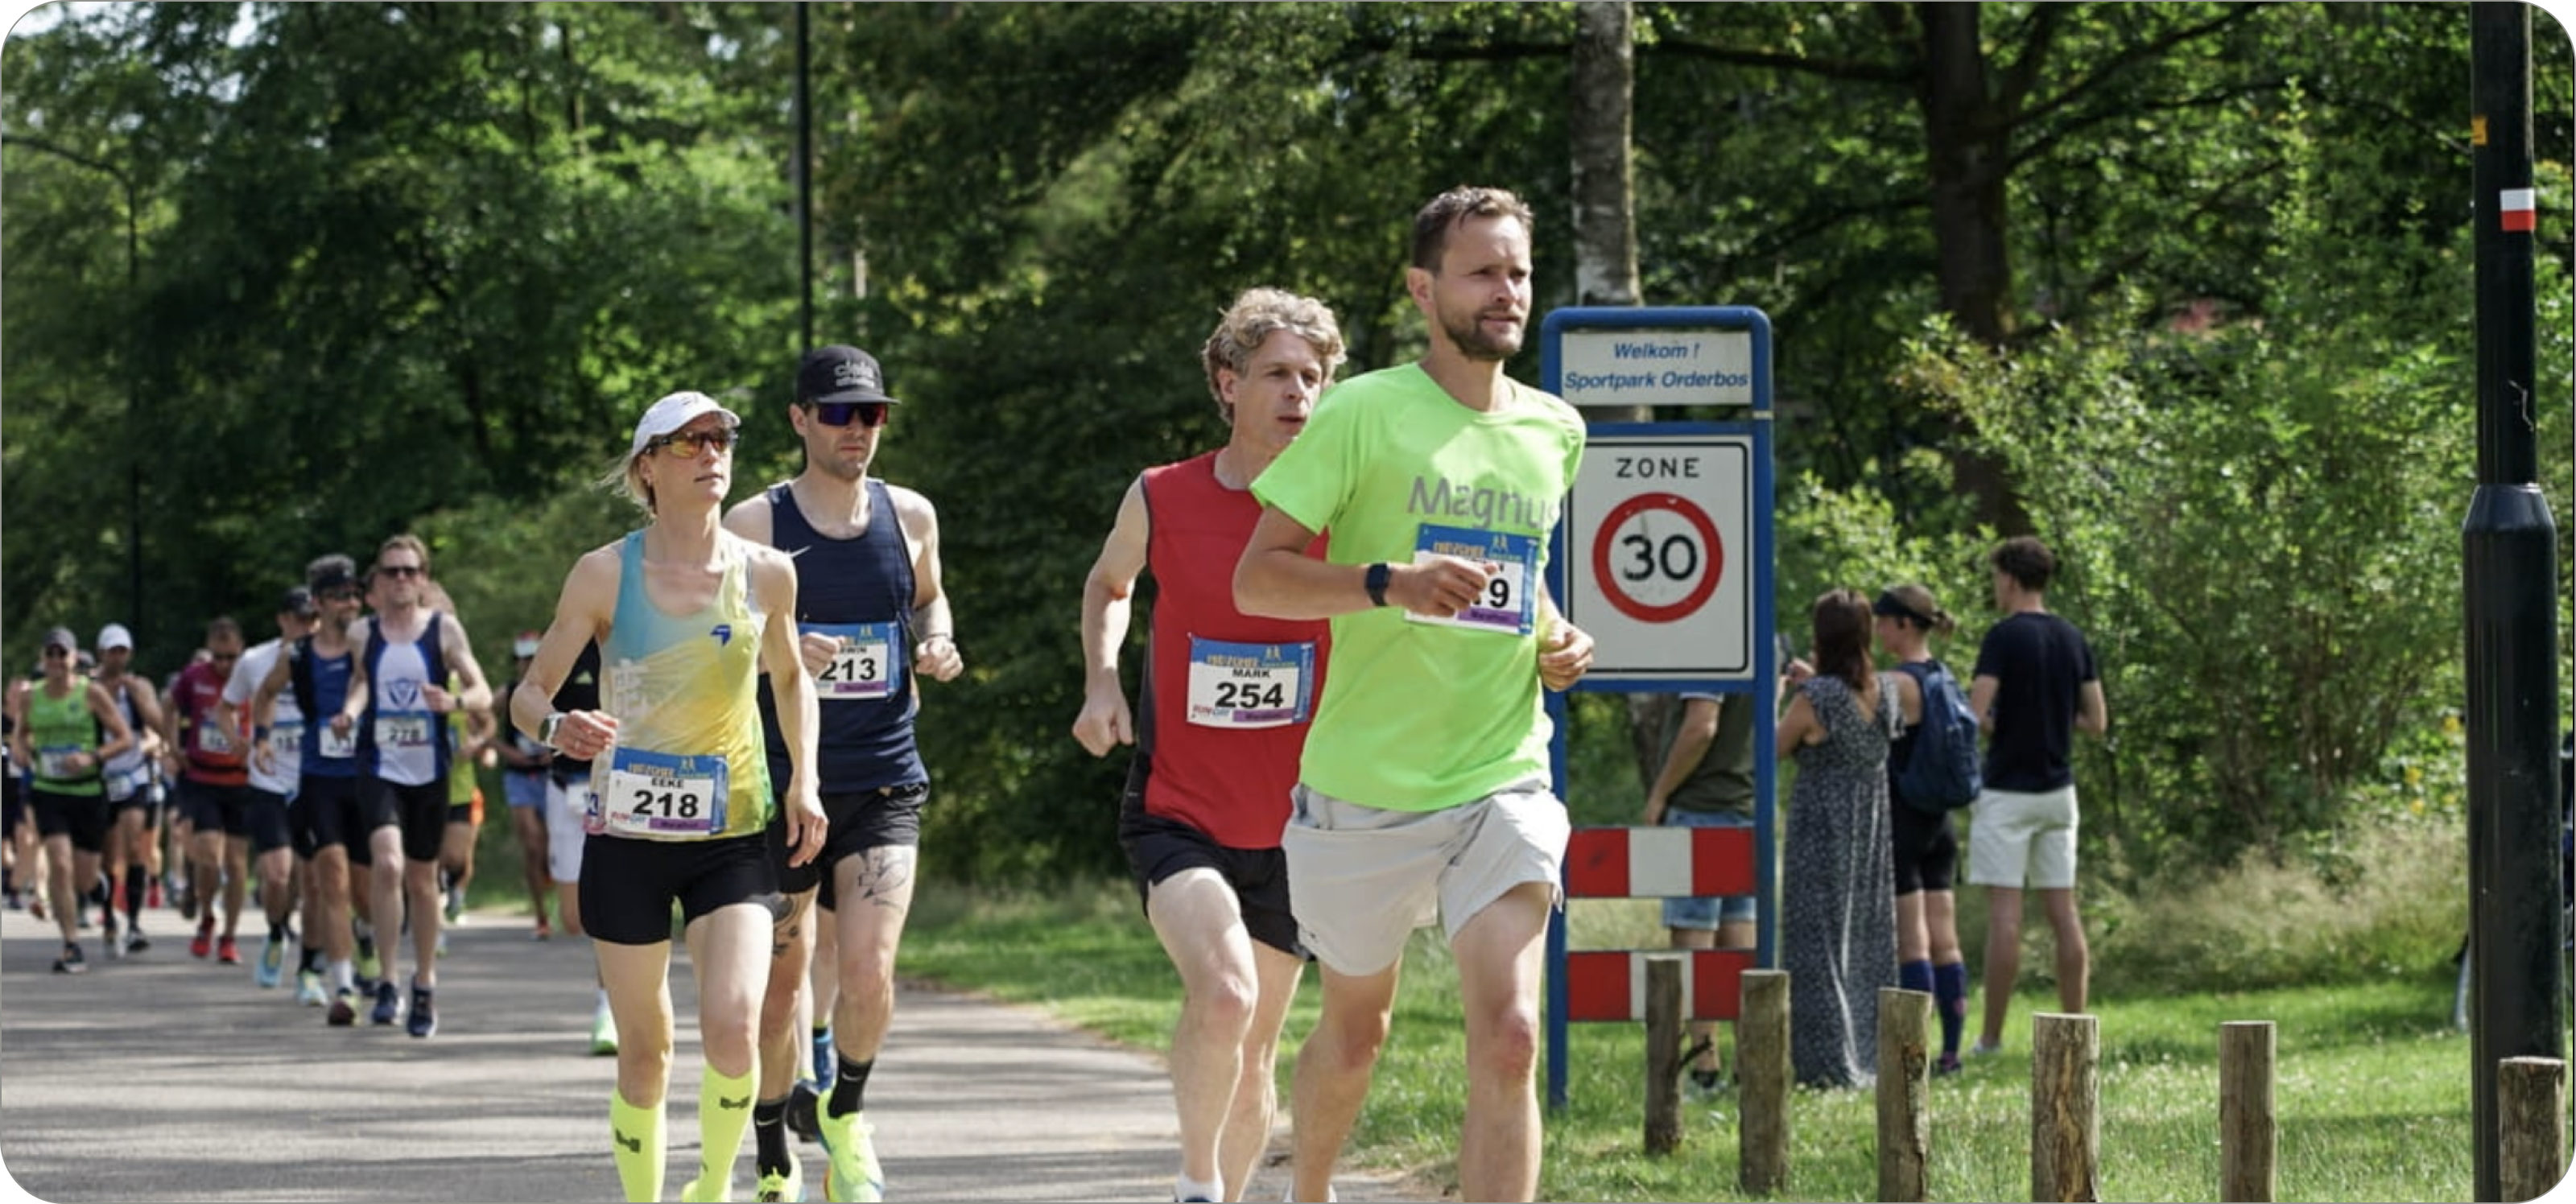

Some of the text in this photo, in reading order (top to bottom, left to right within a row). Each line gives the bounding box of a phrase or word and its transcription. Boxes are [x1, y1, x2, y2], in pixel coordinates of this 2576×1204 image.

[1614, 342, 1688, 359] Welkom
[1565, 369, 1749, 392] Sportpark Orderbos
[1616, 457, 1701, 479] ZONE
[1621, 534, 1698, 582] 30
[818, 658, 877, 682] 213
[1232, 668, 1271, 678] MARK
[1214, 682, 1285, 710] 254
[651, 777, 684, 788] EEKE
[633, 790, 699, 818] 218
